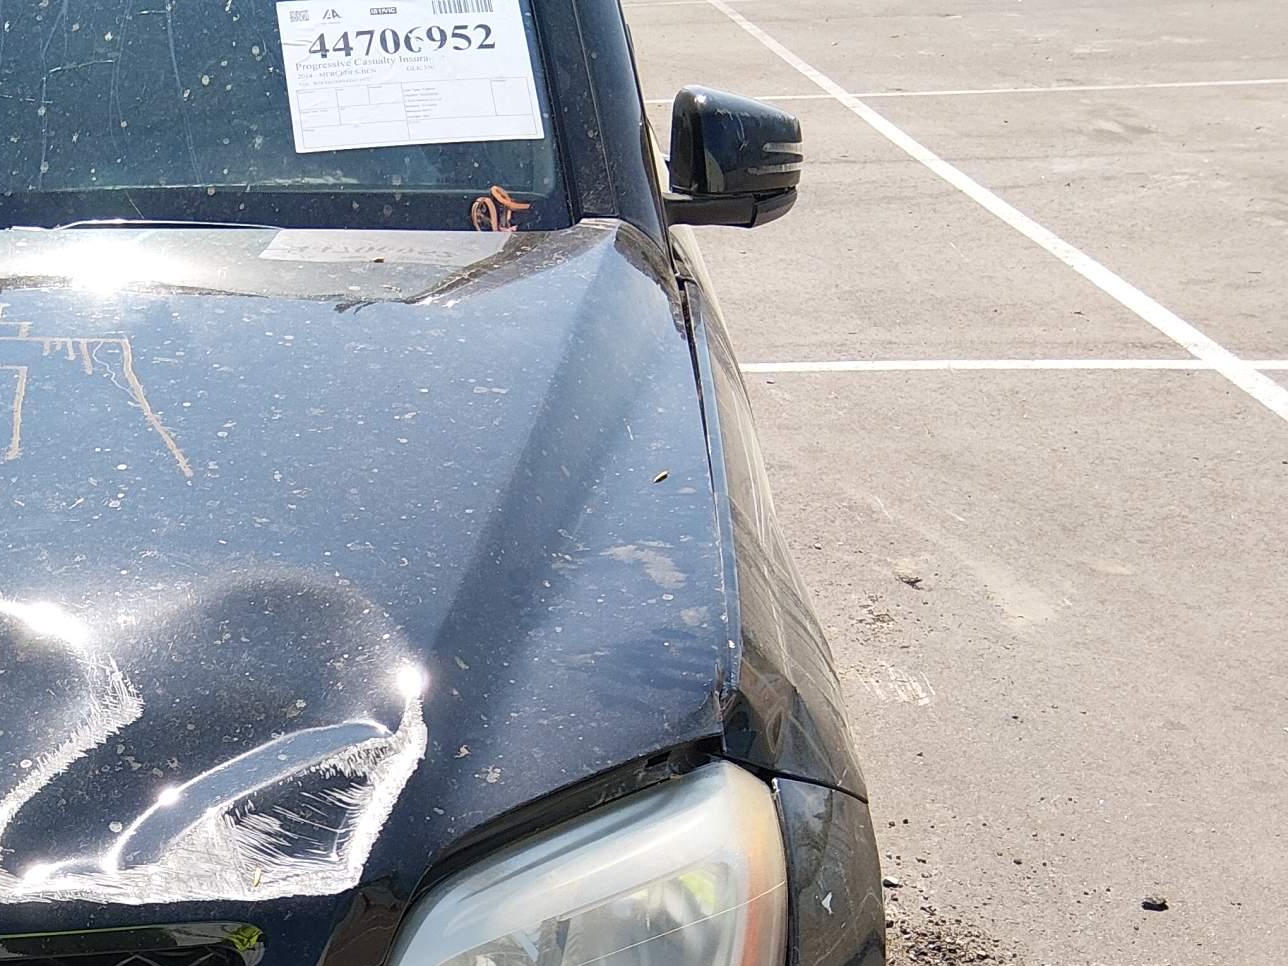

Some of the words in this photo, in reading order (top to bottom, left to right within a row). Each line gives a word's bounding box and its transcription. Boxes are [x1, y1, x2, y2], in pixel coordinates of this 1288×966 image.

[309, 24, 495, 58] 44706952
[296, 60, 352, 72] Progressive
[354, 56, 396, 67] Casualty
